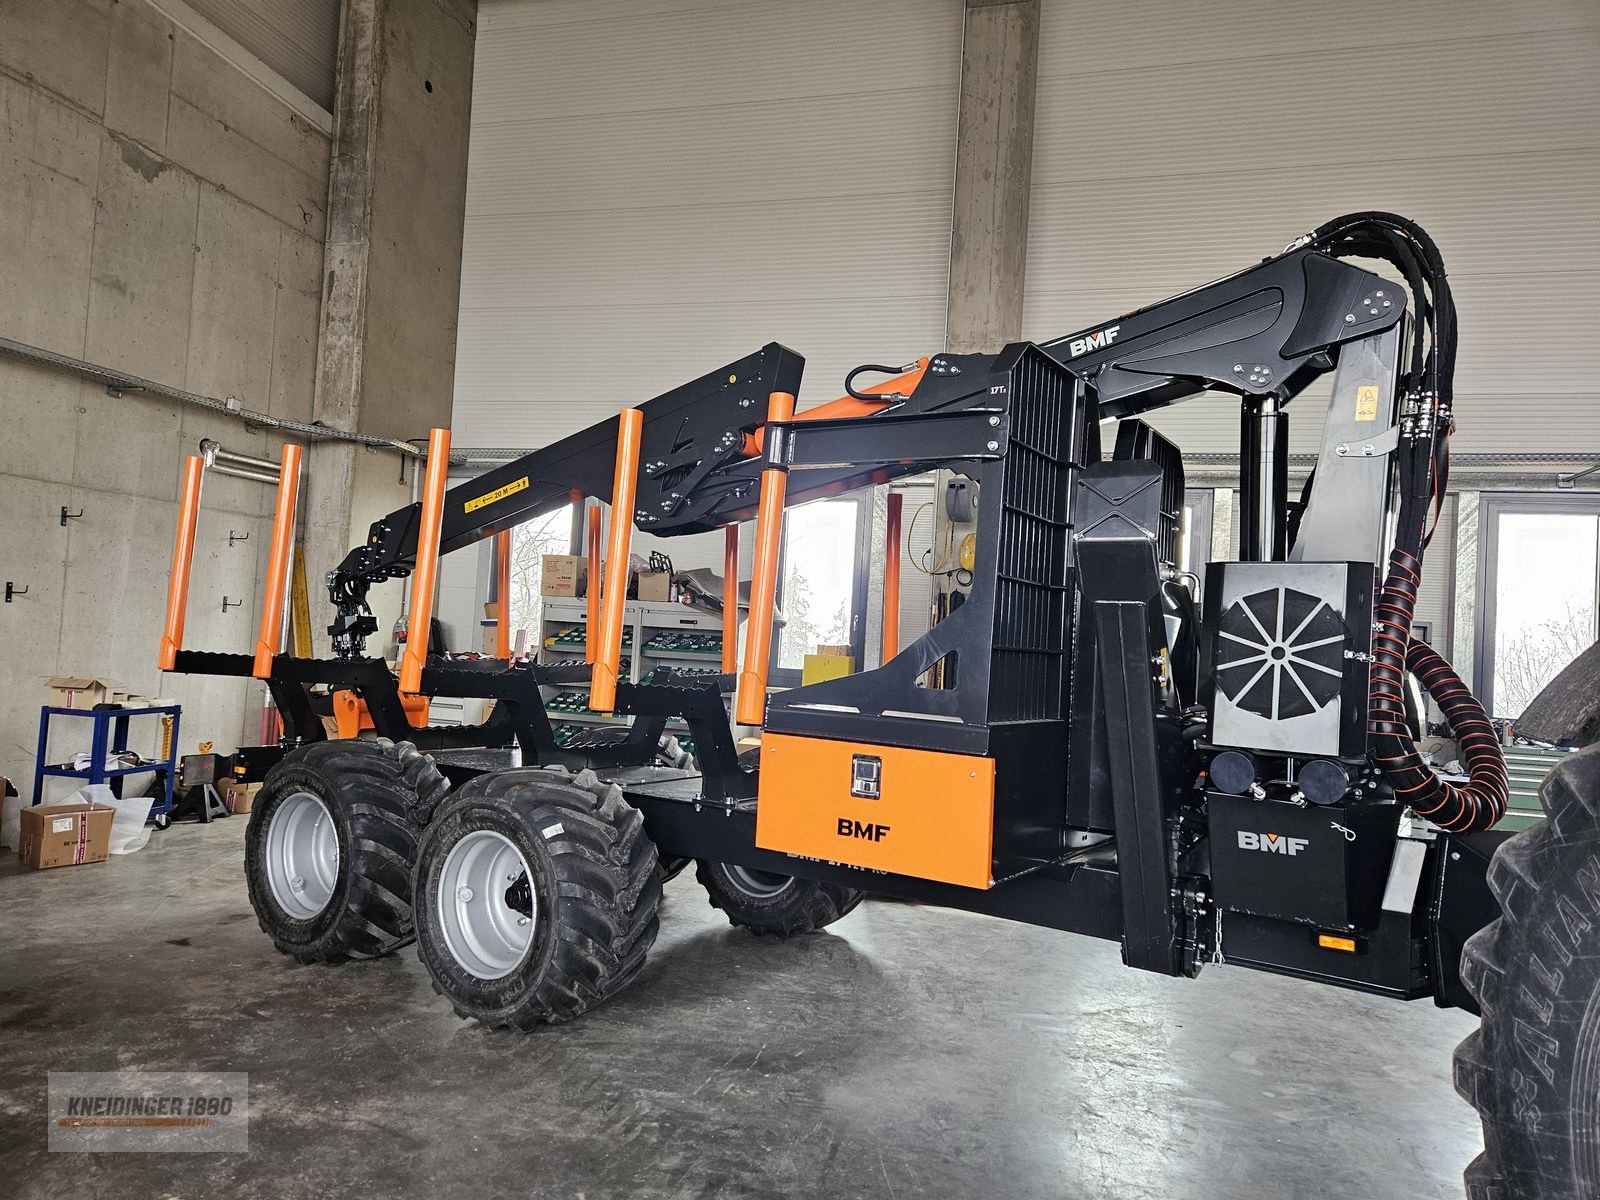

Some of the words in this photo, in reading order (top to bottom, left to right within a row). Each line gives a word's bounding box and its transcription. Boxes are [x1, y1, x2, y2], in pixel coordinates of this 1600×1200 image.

[1069, 325, 1120, 357] BMF
[494, 491, 502, 499] 20
[502, 487, 509, 495] M
[837, 818, 890, 842] BMF
[1237, 830, 1309, 856] BMF
